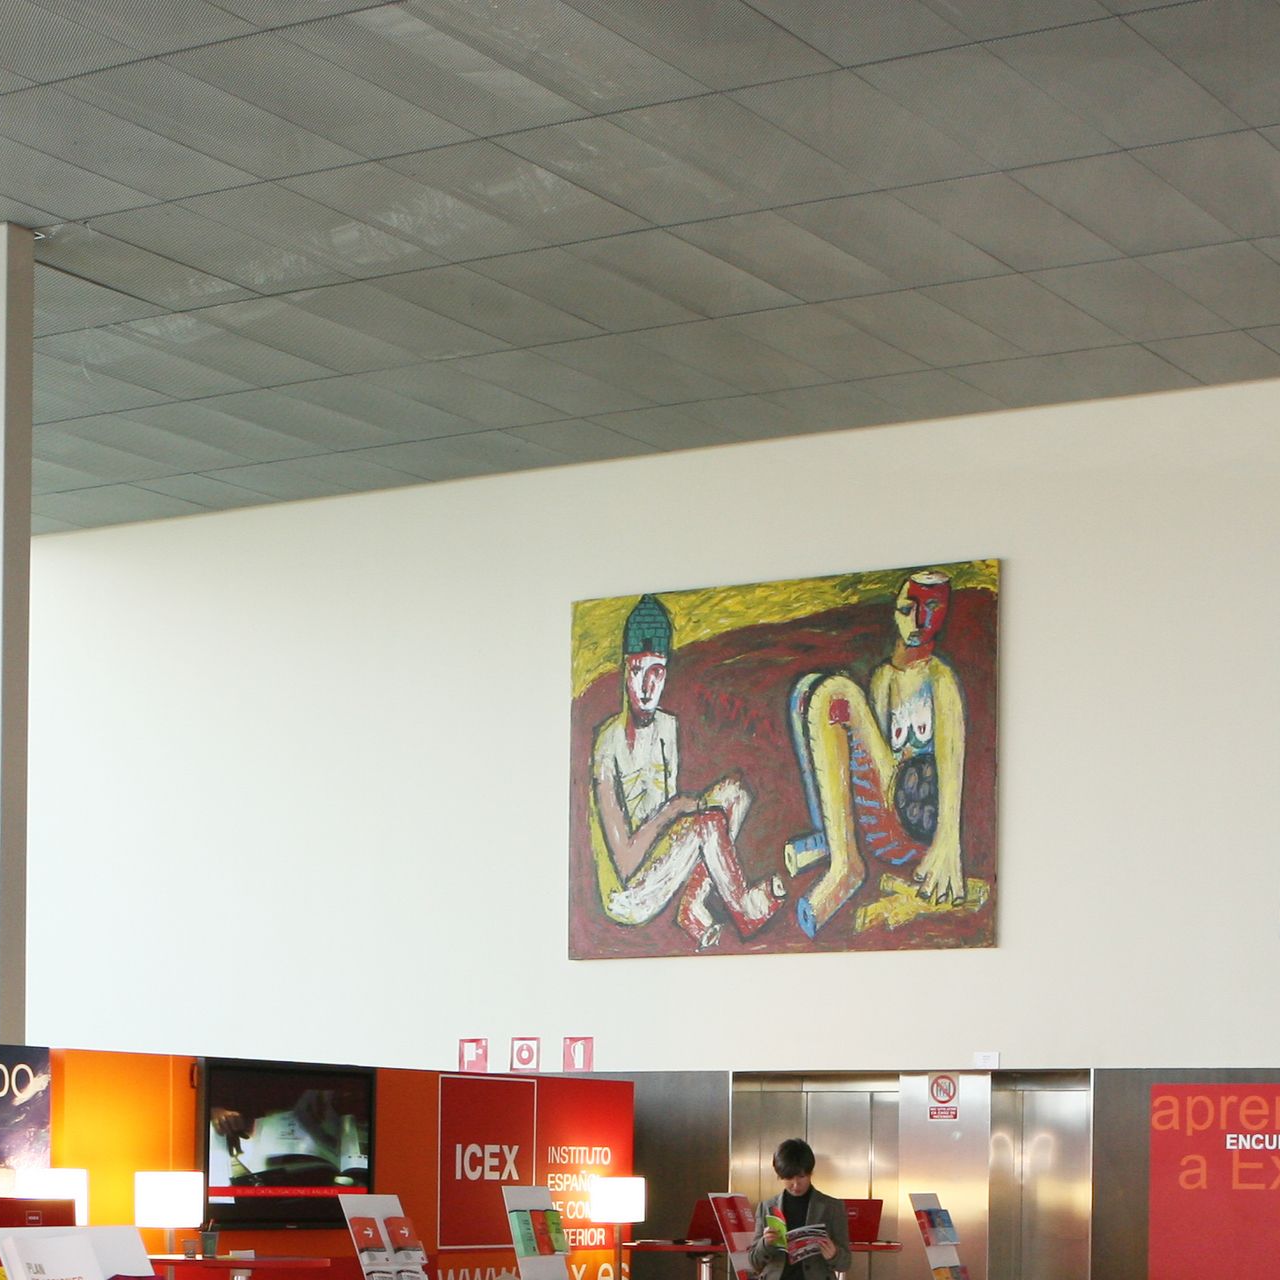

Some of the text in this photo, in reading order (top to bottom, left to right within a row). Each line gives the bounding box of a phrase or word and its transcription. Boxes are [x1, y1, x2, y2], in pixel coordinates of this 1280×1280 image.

[455, 1143, 520, 1181] ICEX
[547, 1146, 612, 1165] INSTITUTO
[1178, 1152, 1208, 1190] a
[26, 1262, 46, 1275] PLAN
